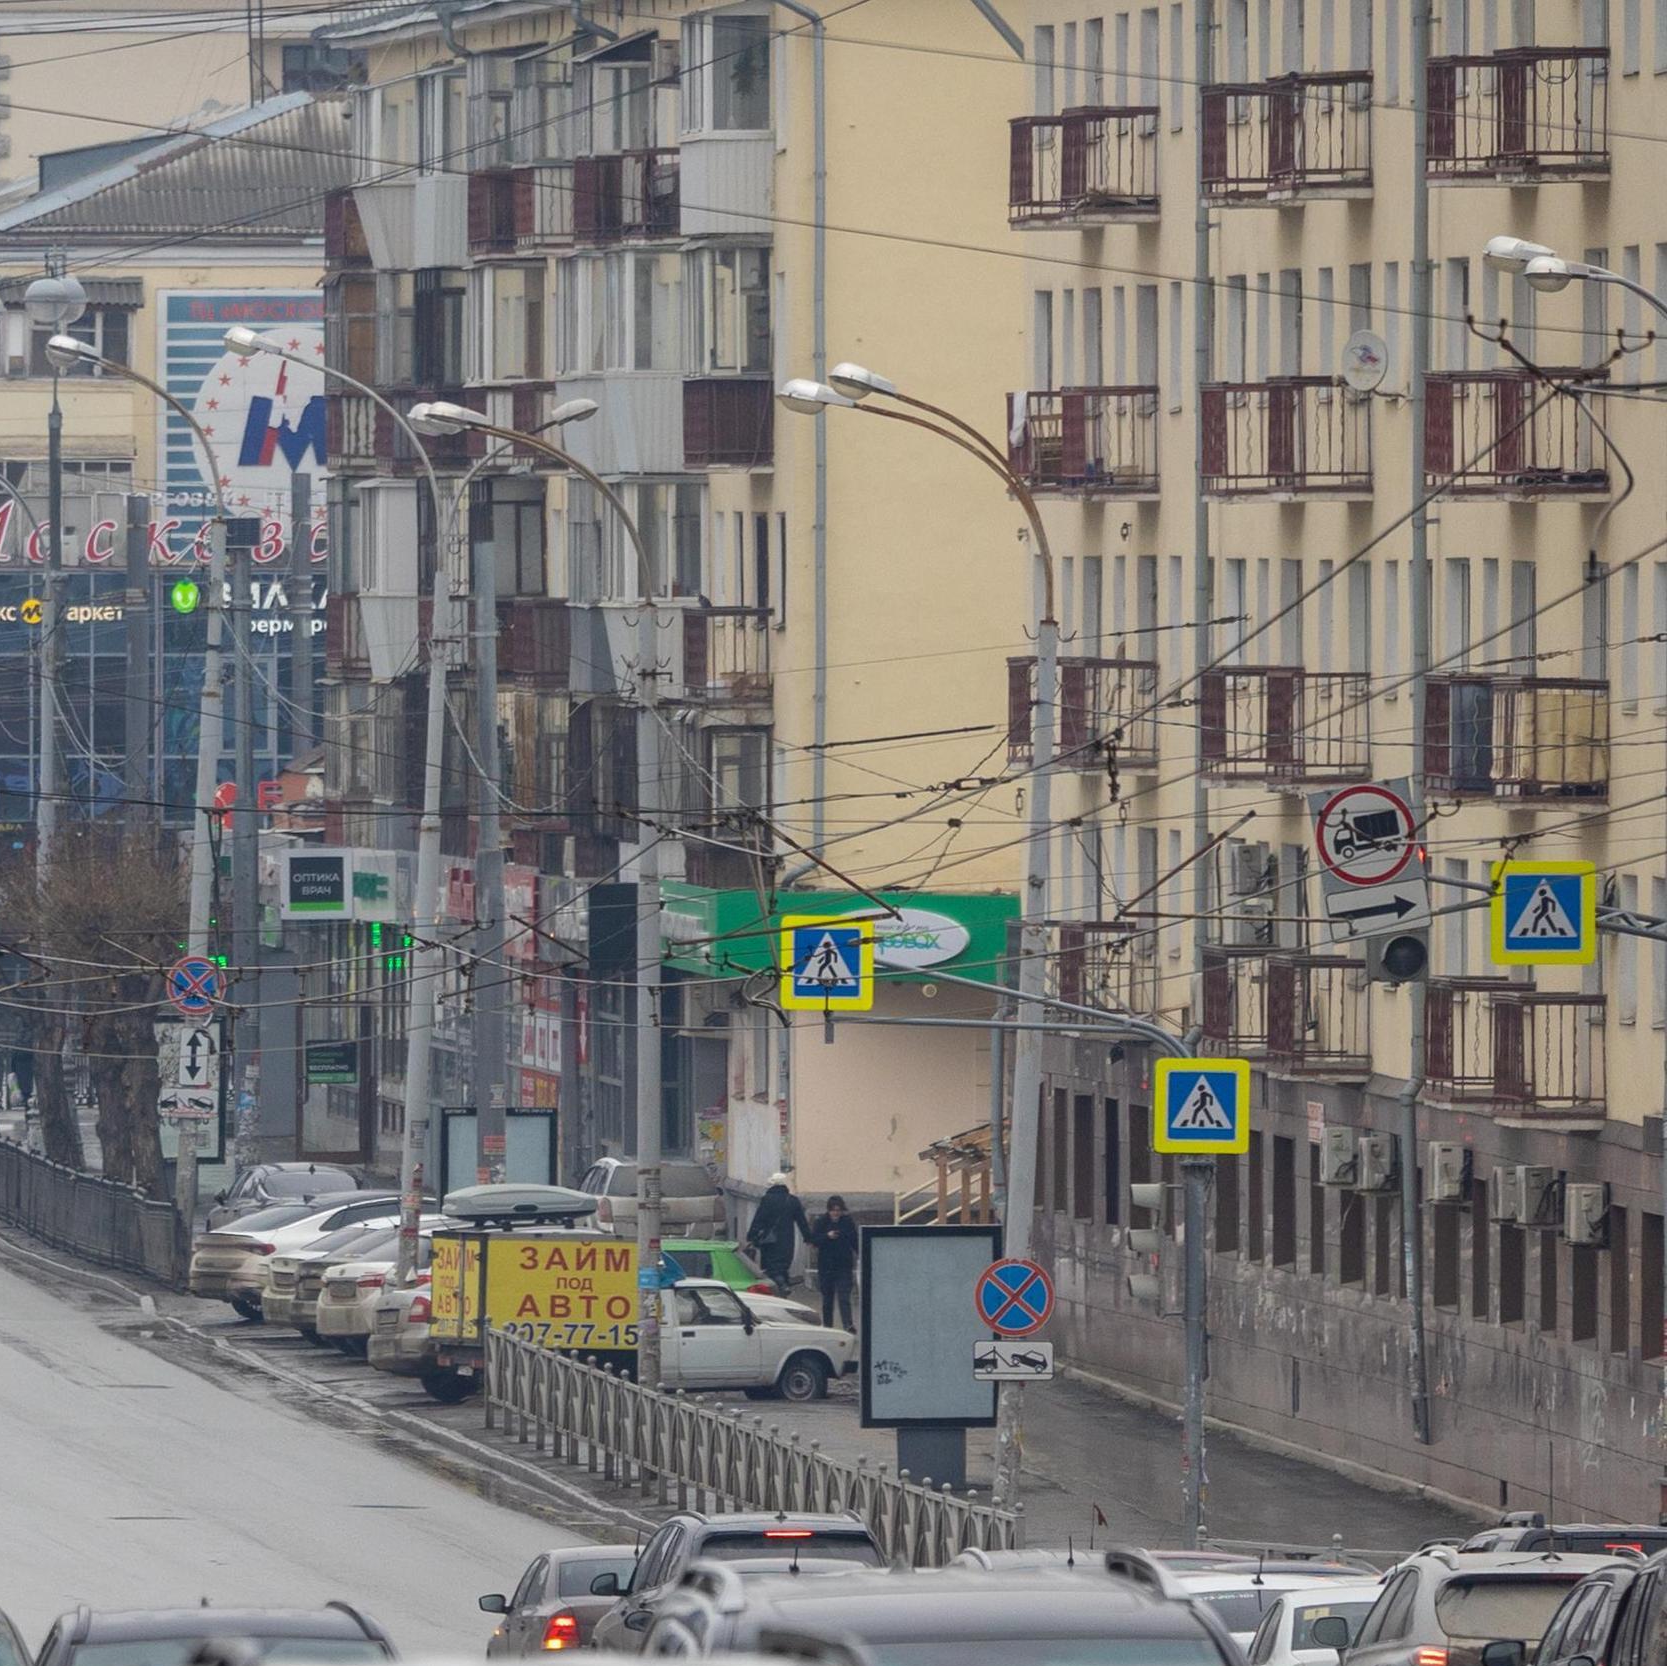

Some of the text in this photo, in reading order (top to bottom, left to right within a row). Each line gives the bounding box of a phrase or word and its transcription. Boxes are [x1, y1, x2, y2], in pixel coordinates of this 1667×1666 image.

[293, 873, 340, 883] ОПТИКА
[302, 886, 332, 896] ВРАЧ
[520, 1241, 630, 1272] ЗАЙМ
[556, 1277, 594, 1292] под
[516, 1294, 631, 1320] АВТО
